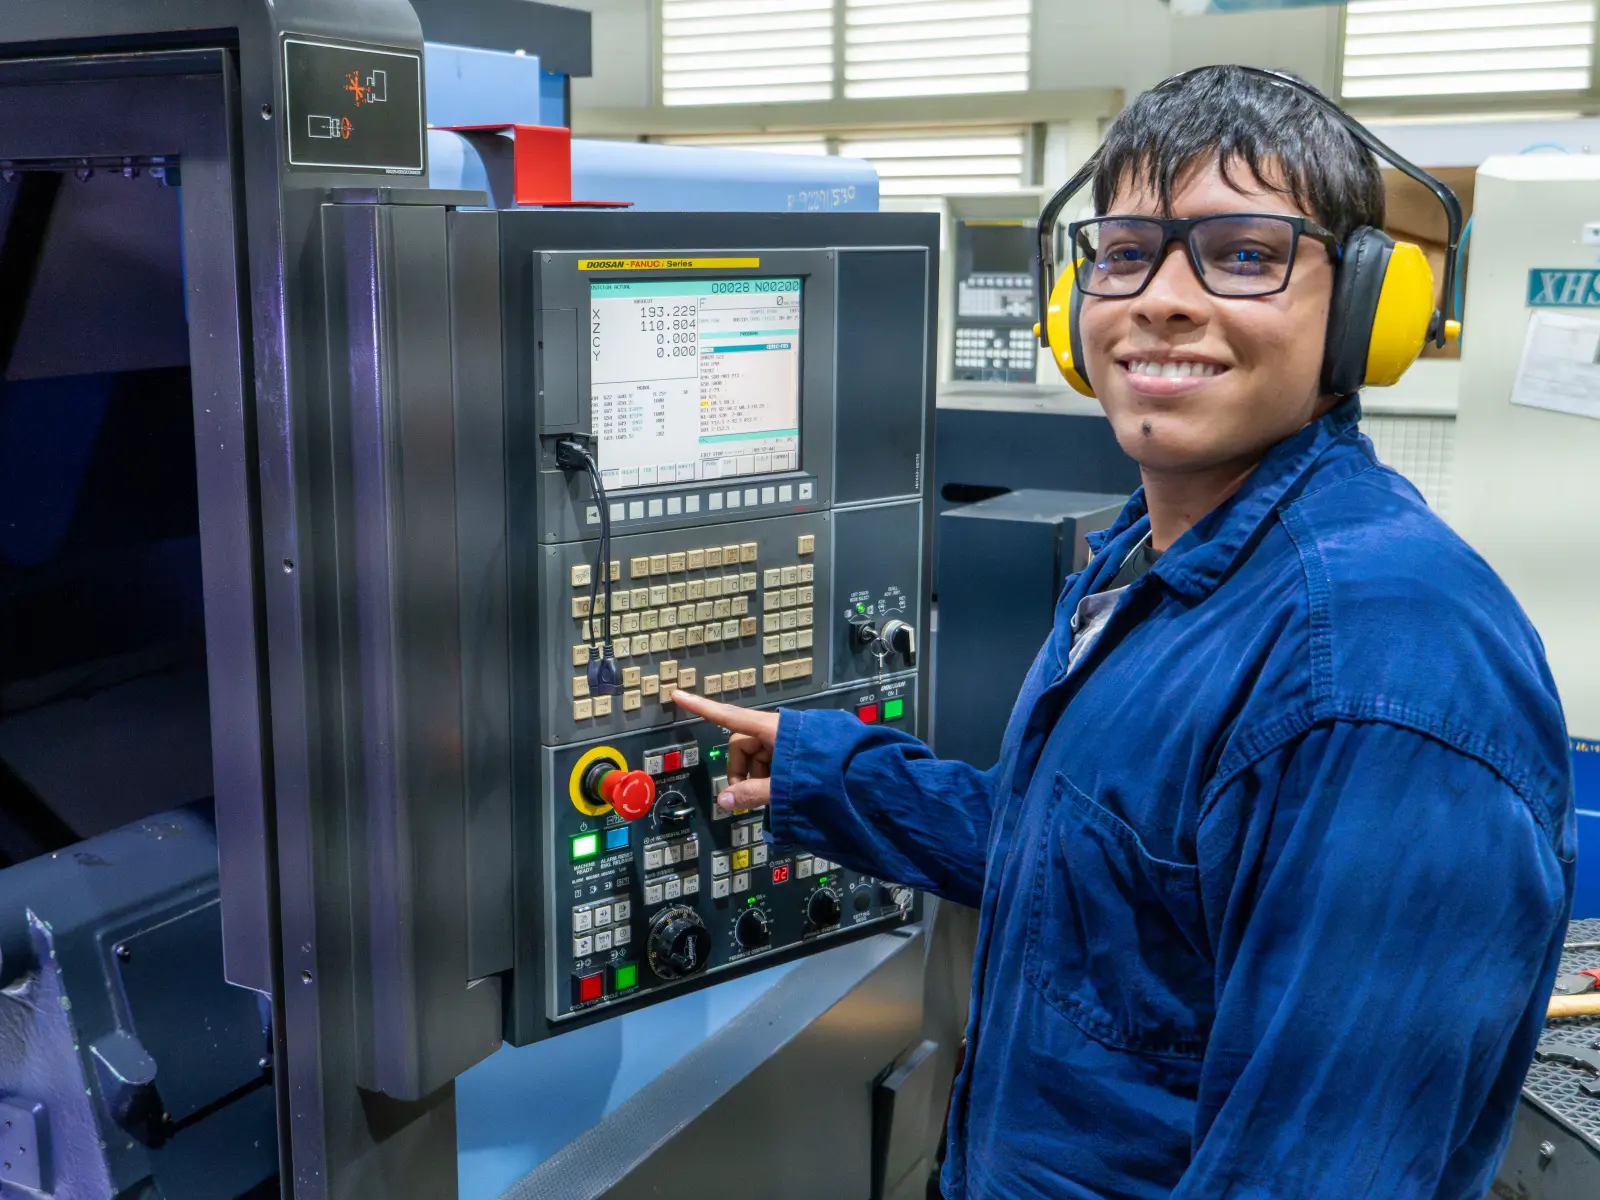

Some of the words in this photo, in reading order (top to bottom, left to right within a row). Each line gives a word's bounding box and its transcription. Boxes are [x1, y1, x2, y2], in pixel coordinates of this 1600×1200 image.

[666, 260, 693, 269] Series
[754, 281, 800, 293] N00200
[592, 309, 601, 320] X
[640, 306, 697, 318] 193.229
[592, 322, 601, 334] Z
[640, 319, 697, 332] 110.804
[592, 336, 601, 348] C
[656, 332, 697, 345] 0.000
[592, 350, 601, 362] Y
[656, 346, 697, 358] 0.000
[859, 695, 870, 703] OFF
[576, 867, 593, 876] READY
[773, 866, 788, 881] 02
